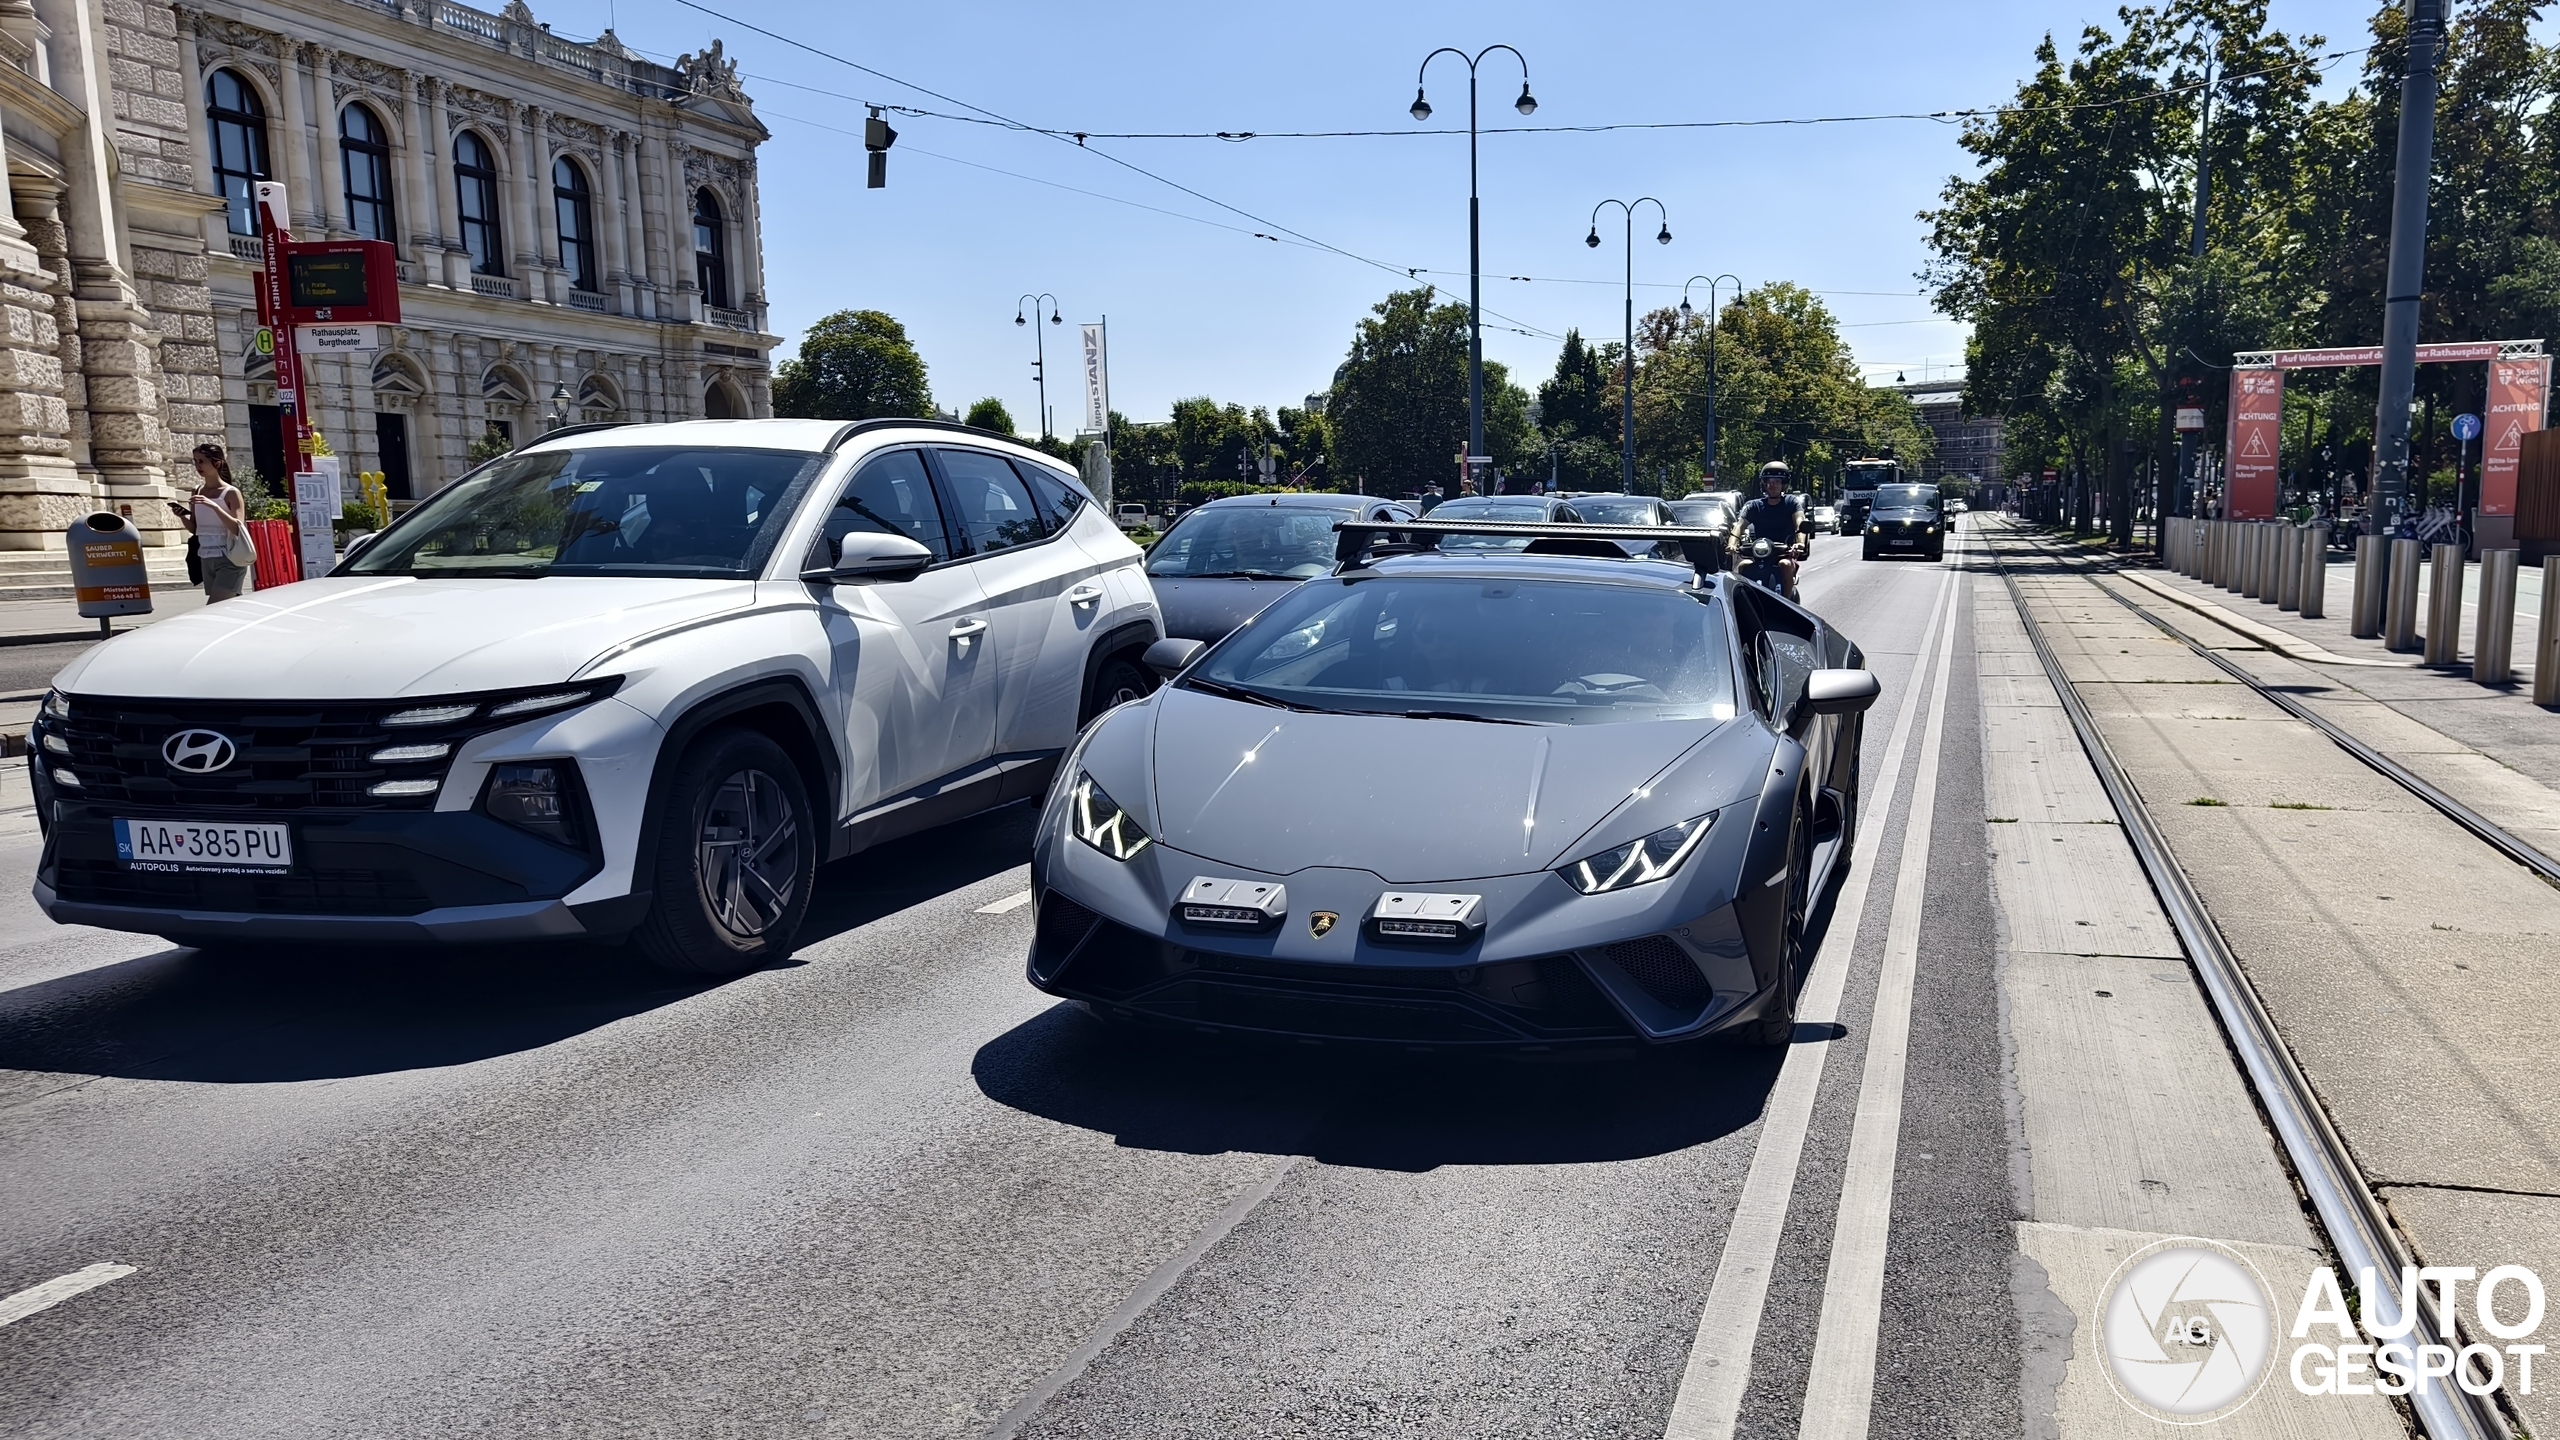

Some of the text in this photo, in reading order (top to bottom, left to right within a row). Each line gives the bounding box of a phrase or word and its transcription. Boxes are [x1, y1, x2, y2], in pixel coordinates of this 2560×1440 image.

[267, 233, 281, 310] WIENER LINIEN
[311, 328, 360, 337] Rathausplatz,
[260, 333, 271, 349] H
[318, 338, 361, 347] Burgtheater
[279, 348, 284, 356] 1
[2281, 354, 2297, 363] Auf
[2298, 352, 2357, 362] Wiedersehen
[2358, 351, 2373, 360] auf
[2430, 347, 2492, 358] Rathausplatz!
[278, 360, 288, 369] 71
[281, 375, 288, 384] D
[1083, 328, 1103, 427] IMPULSTANZ
[279, 390, 293, 400] U2Z
[2256, 386, 2275, 394] Wien
[2238, 412, 2277, 421] ACHTUNG!
[118, 842, 131, 853] SK
[130, 862, 179, 872] AUTOPOLIS
